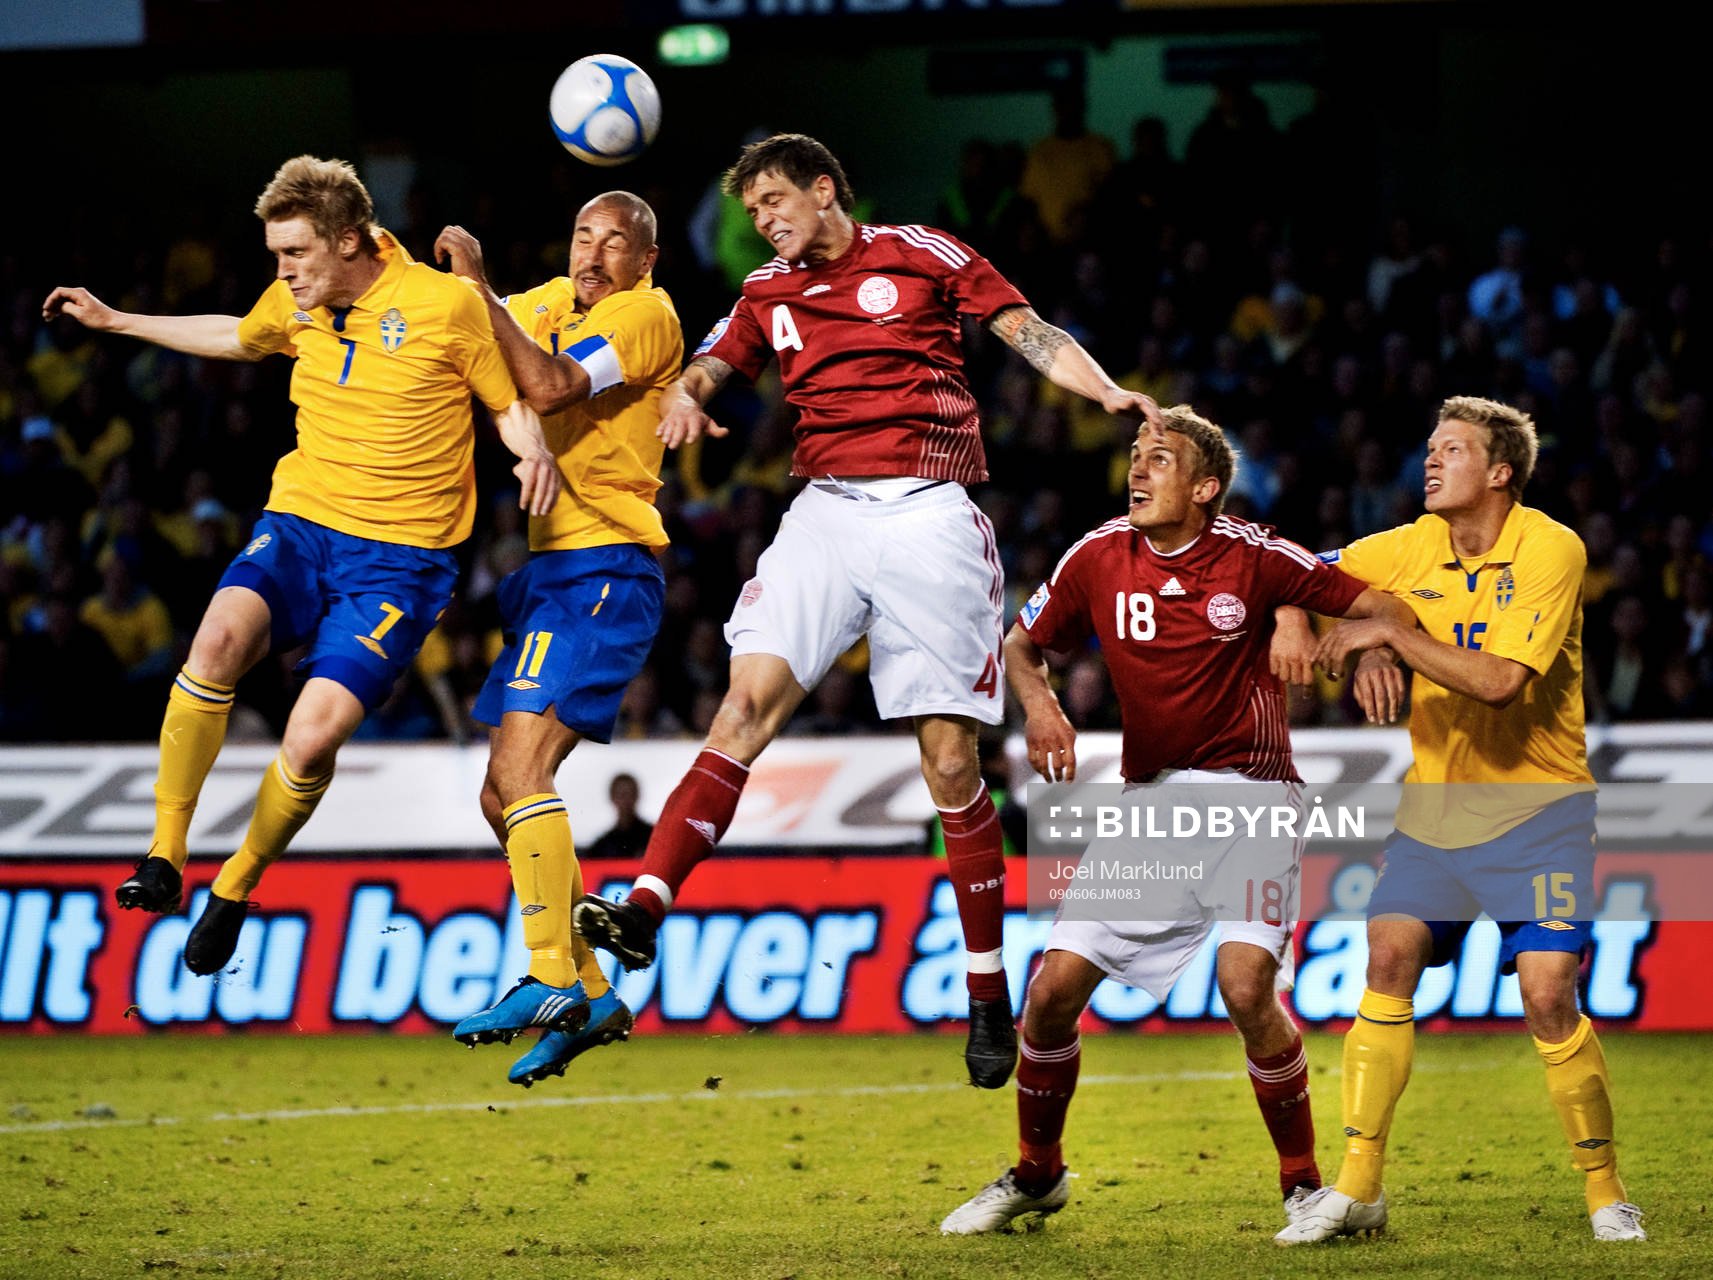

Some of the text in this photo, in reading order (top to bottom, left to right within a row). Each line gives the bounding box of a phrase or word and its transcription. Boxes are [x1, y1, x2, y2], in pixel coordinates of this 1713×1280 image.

[772, 304, 804, 351] 4
[337, 337, 357, 385] 7
[369, 601, 405, 641] 7
[1115, 591, 1157, 641] 18
[514, 631, 554, 678] 11
[972, 651, 998, 700] 4
[1246, 878, 1284, 927] 18
[1531, 872, 1577, 919] 15
[135, 888, 308, 1023] du
